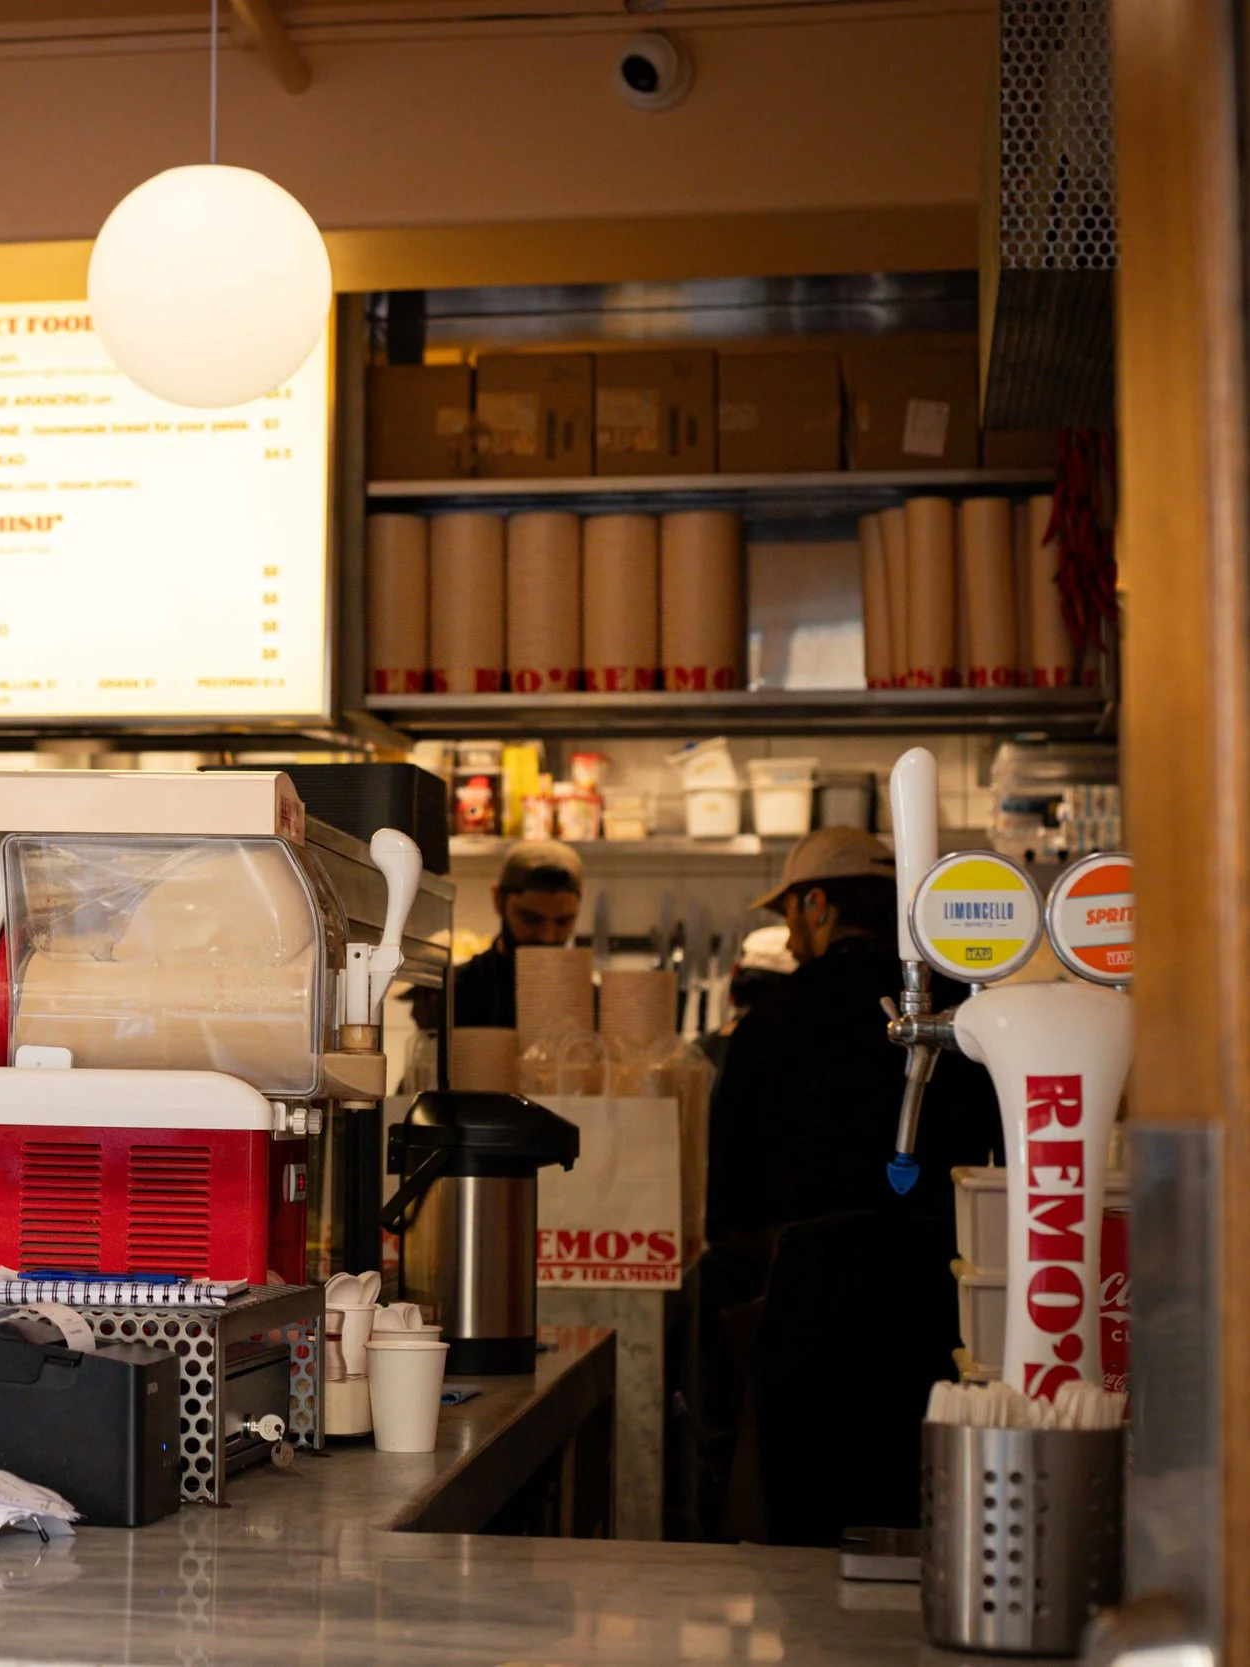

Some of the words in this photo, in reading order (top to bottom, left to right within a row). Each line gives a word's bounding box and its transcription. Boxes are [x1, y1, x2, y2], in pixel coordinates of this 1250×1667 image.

[33, 424, 107, 435] homemade
[153, 421, 172, 433] for
[943, 902, 1015, 920] LIMONCELLO
[966, 948, 992, 960] TAP
